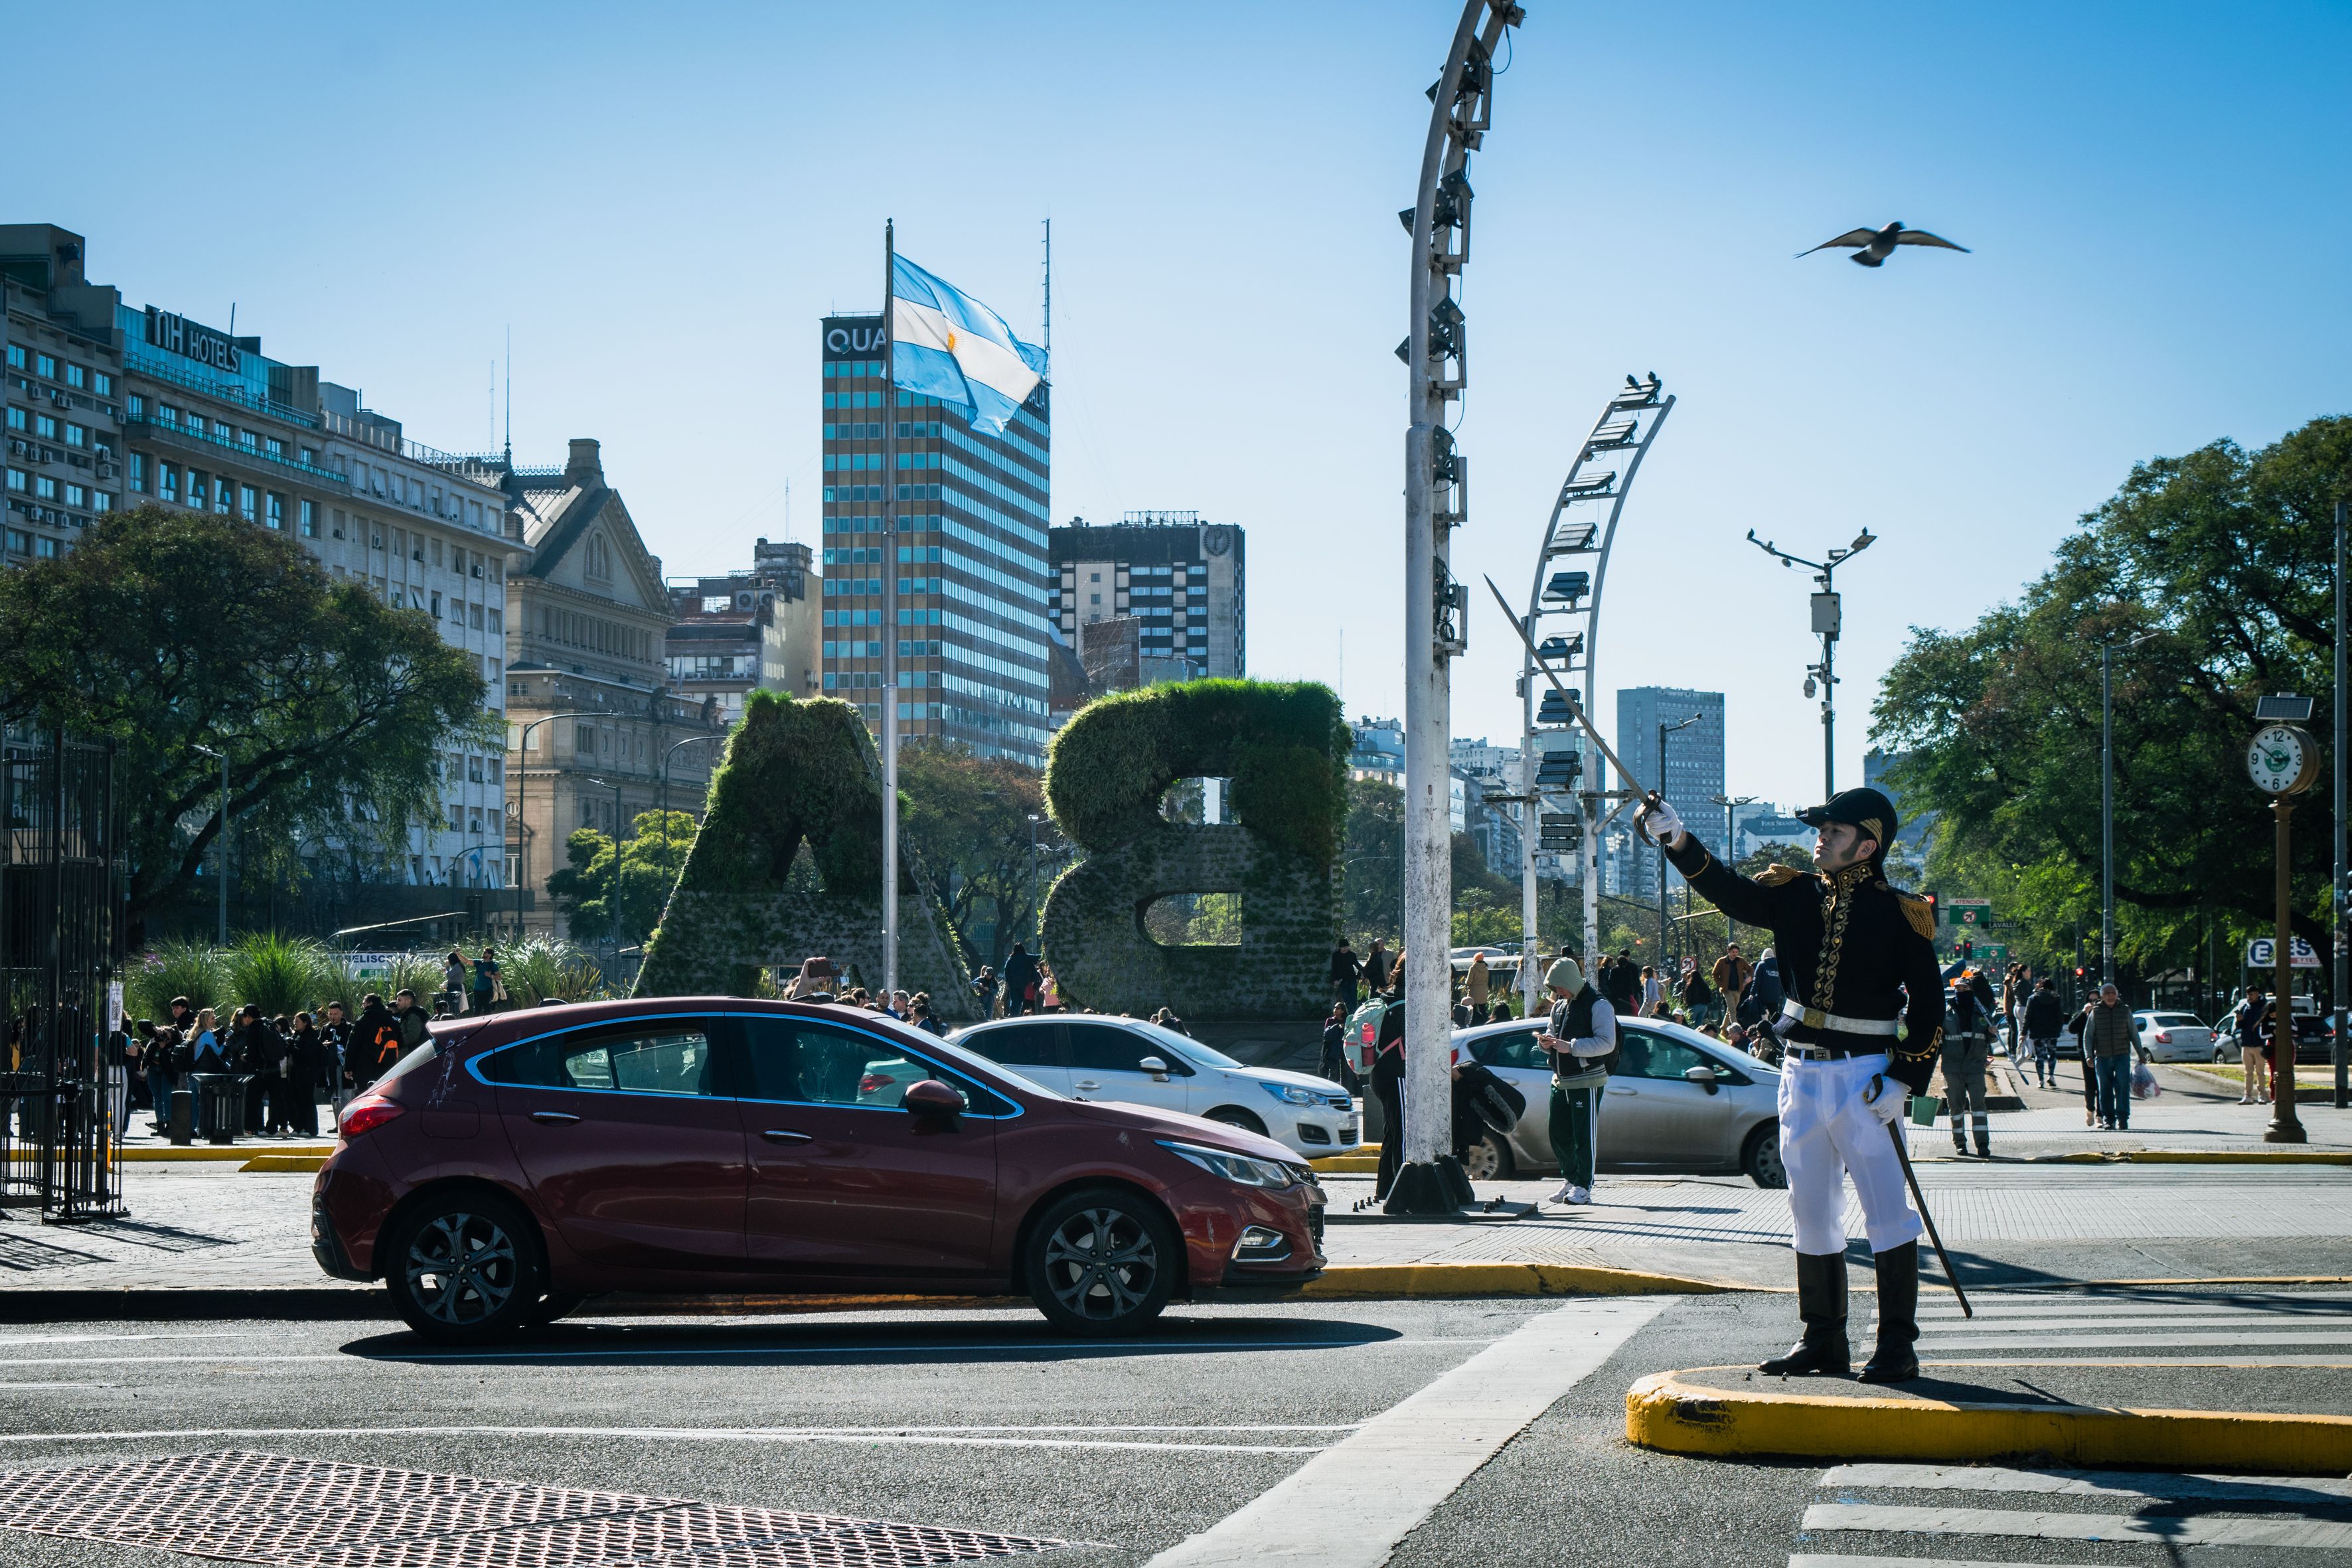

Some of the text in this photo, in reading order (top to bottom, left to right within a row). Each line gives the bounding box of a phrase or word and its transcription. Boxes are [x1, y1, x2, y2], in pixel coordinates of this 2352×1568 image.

[191, 330, 238, 372] HOTELS
[2272, 731, 2284, 742] 12
[2252, 753, 2258, 764] 9
[2296, 754, 2302, 765] 3
[2273, 778, 2280, 790] 6
